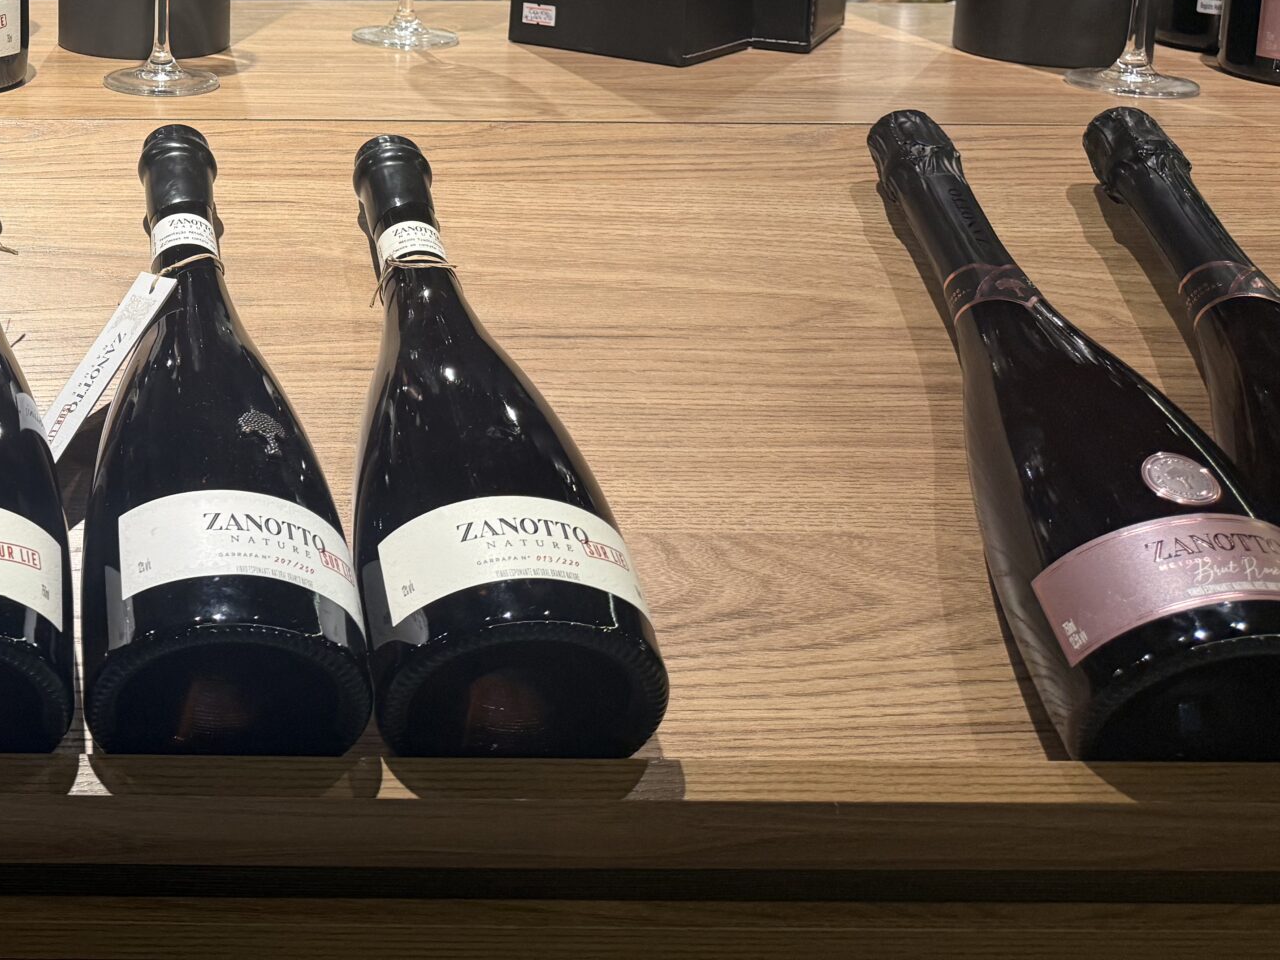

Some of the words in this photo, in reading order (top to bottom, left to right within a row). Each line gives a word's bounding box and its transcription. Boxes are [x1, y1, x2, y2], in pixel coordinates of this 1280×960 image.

[68, 332, 127, 413] ZANOTTO
[203, 512, 326, 553] ZANOTTO
[457, 517, 589, 544] ZANOTTO
[20, 548, 38, 566] LIE
[230, 535, 312, 559] NATURE
[486, 539, 575, 552] NATURE
[586, 542, 609, 560] SUR
[476, 555, 518, 566] GARRAFA
[536, 555, 580, 567] 013/220
[1193, 559, 1239, 584] Brut
